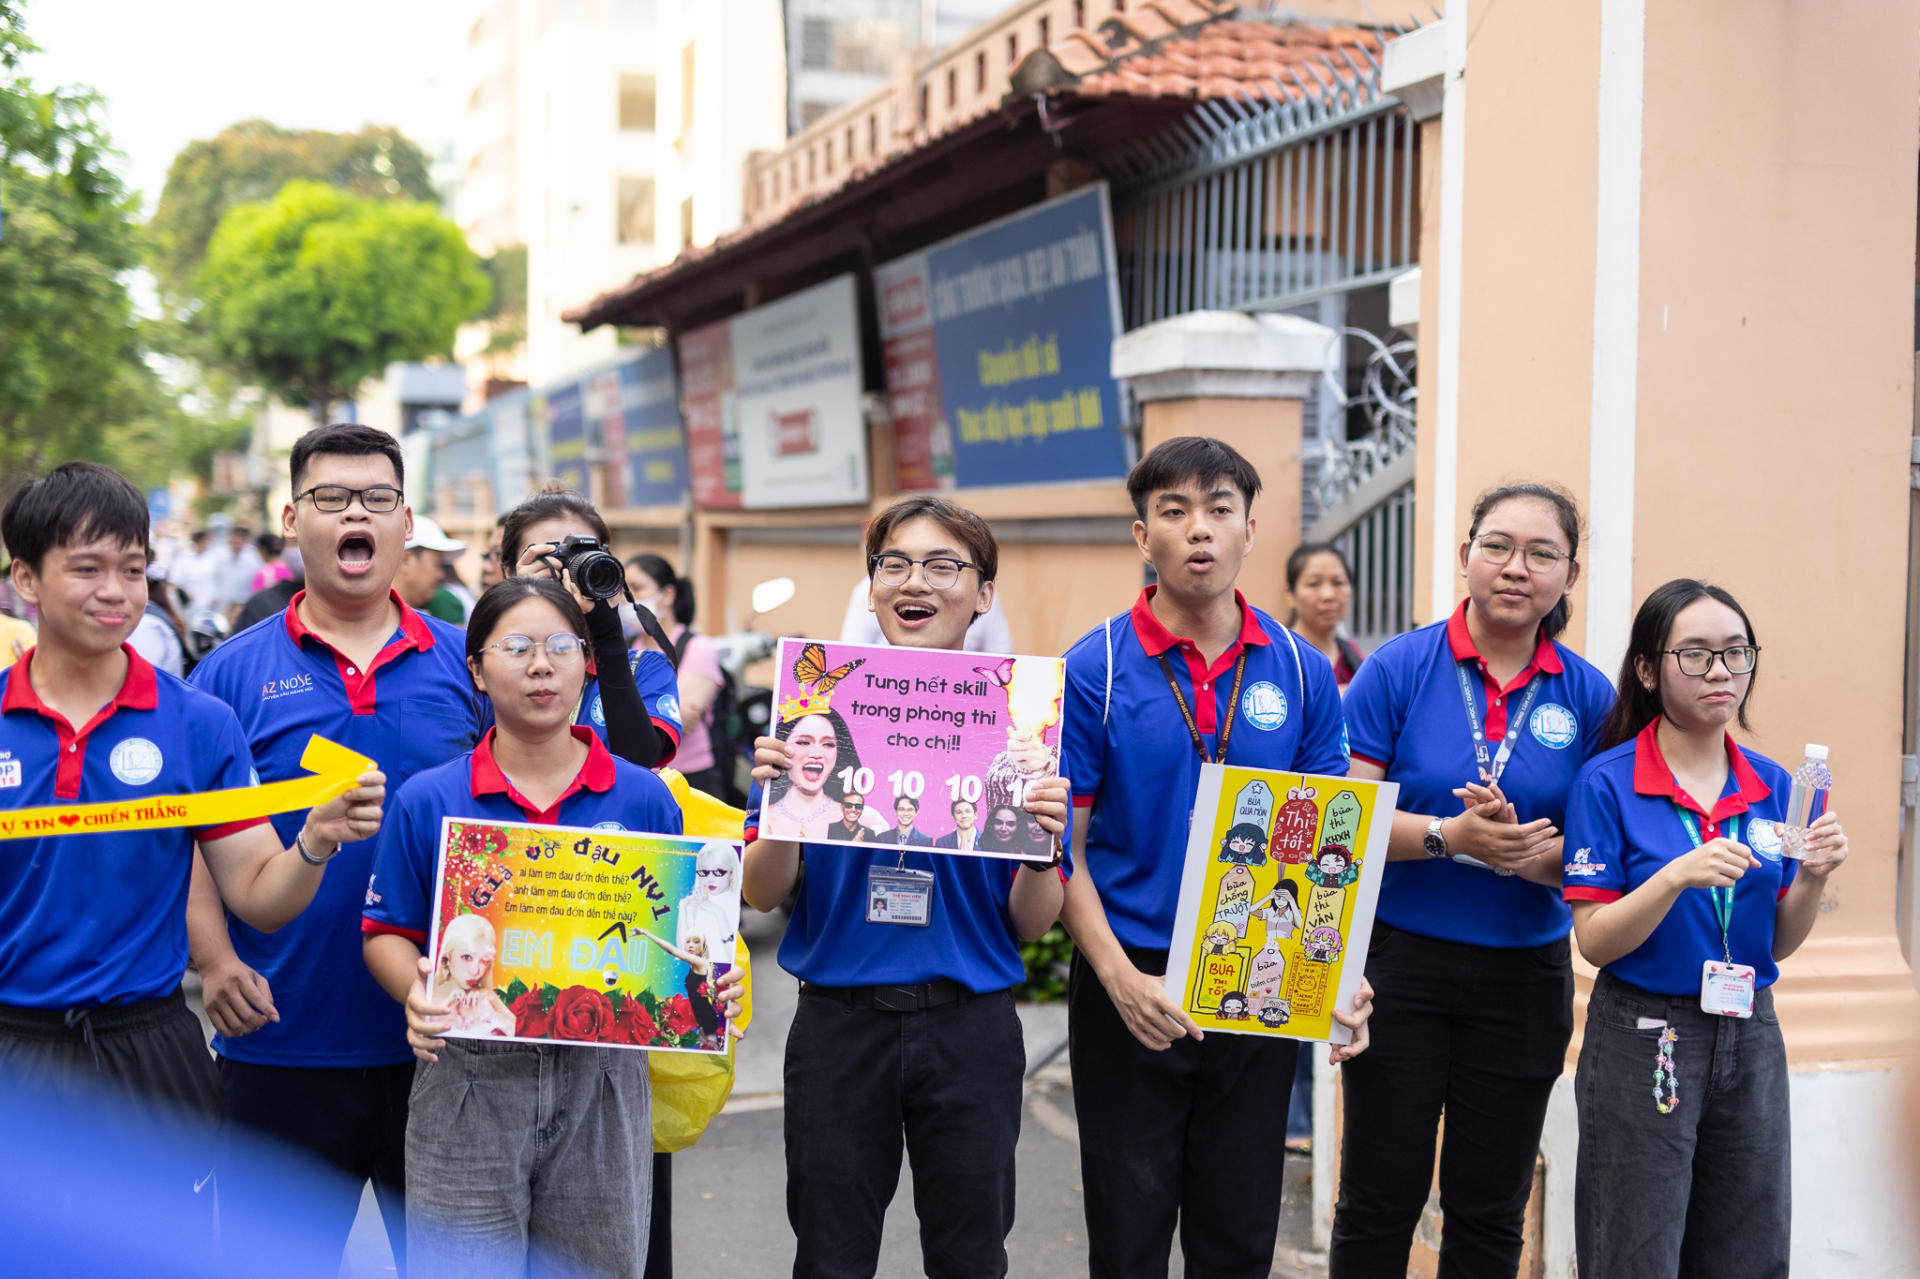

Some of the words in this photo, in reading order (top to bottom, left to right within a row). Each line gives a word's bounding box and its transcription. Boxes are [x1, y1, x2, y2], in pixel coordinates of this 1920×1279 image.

[262, 682, 277, 696] AZ
[280, 674, 312, 690] NOSE
[865, 674, 910, 695] Tung
[916, 676, 948, 693] hết
[953, 680, 988, 696] skill
[852, 700, 900, 723] trong
[906, 704, 966, 728] phòng
[972, 709, 996, 725] thi
[886, 733, 919, 747] cho
[925, 735, 961, 753] chị!!
[838, 766, 876, 795] 10
[888, 770, 925, 799] 10
[946, 774, 982, 803] 10
[22, 818, 55, 830] TIN
[84, 807, 130, 826] CHIẾN
[134, 800, 187, 821] THẮNG
[1240, 806, 1254, 815] QUA
[1254, 806, 1267, 816] MÔN
[1286, 810, 1311, 829] Thi
[1332, 807, 1354, 817] bùa
[1330, 816, 1346, 830] thi
[1280, 830, 1304, 850] tốt
[1325, 830, 1350, 845] KHXH
[471, 864, 514, 909] Giả
[525, 842, 558, 861] vờ
[573, 837, 621, 867] đậu
[520, 867, 526, 877] ai
[529, 868, 542, 878] làm
[545, 871, 556, 879] em
[559, 870, 573, 880] đau
[575, 871, 593, 882] đớn
[595, 871, 610, 884] đến
[612, 873, 630, 885] thế?
[514, 885, 528, 895] anh
[530, 886, 545, 897] làm
[547, 889, 558, 898] em
[561, 888, 575, 898] đau
[578, 890, 595, 900] đớn
[598, 889, 612, 902] đến
[614, 891, 632, 904] thế?
[1226, 881, 1247, 891] bùa
[1317, 890, 1338, 900] bùa
[1220, 890, 1248, 905] chống
[1314, 900, 1330, 912] thi
[505, 902, 517, 912] Em
[520, 903, 534, 913] làm
[536, 906, 548, 914] em
[550, 906, 564, 916] đau
[566, 906, 584, 918] đớn
[586, 906, 600, 918] đến
[603, 908, 616, 920] thế
[618, 911, 638, 924] này?
[1216, 902, 1249, 918] TRƯỢT
[1308, 912, 1334, 928] VĂN
[501, 929, 552, 968] EM
[1209, 958, 1235, 977] BÙA
[1257, 962, 1278, 972] bùa
[1208, 986, 1227, 996] TỐT
